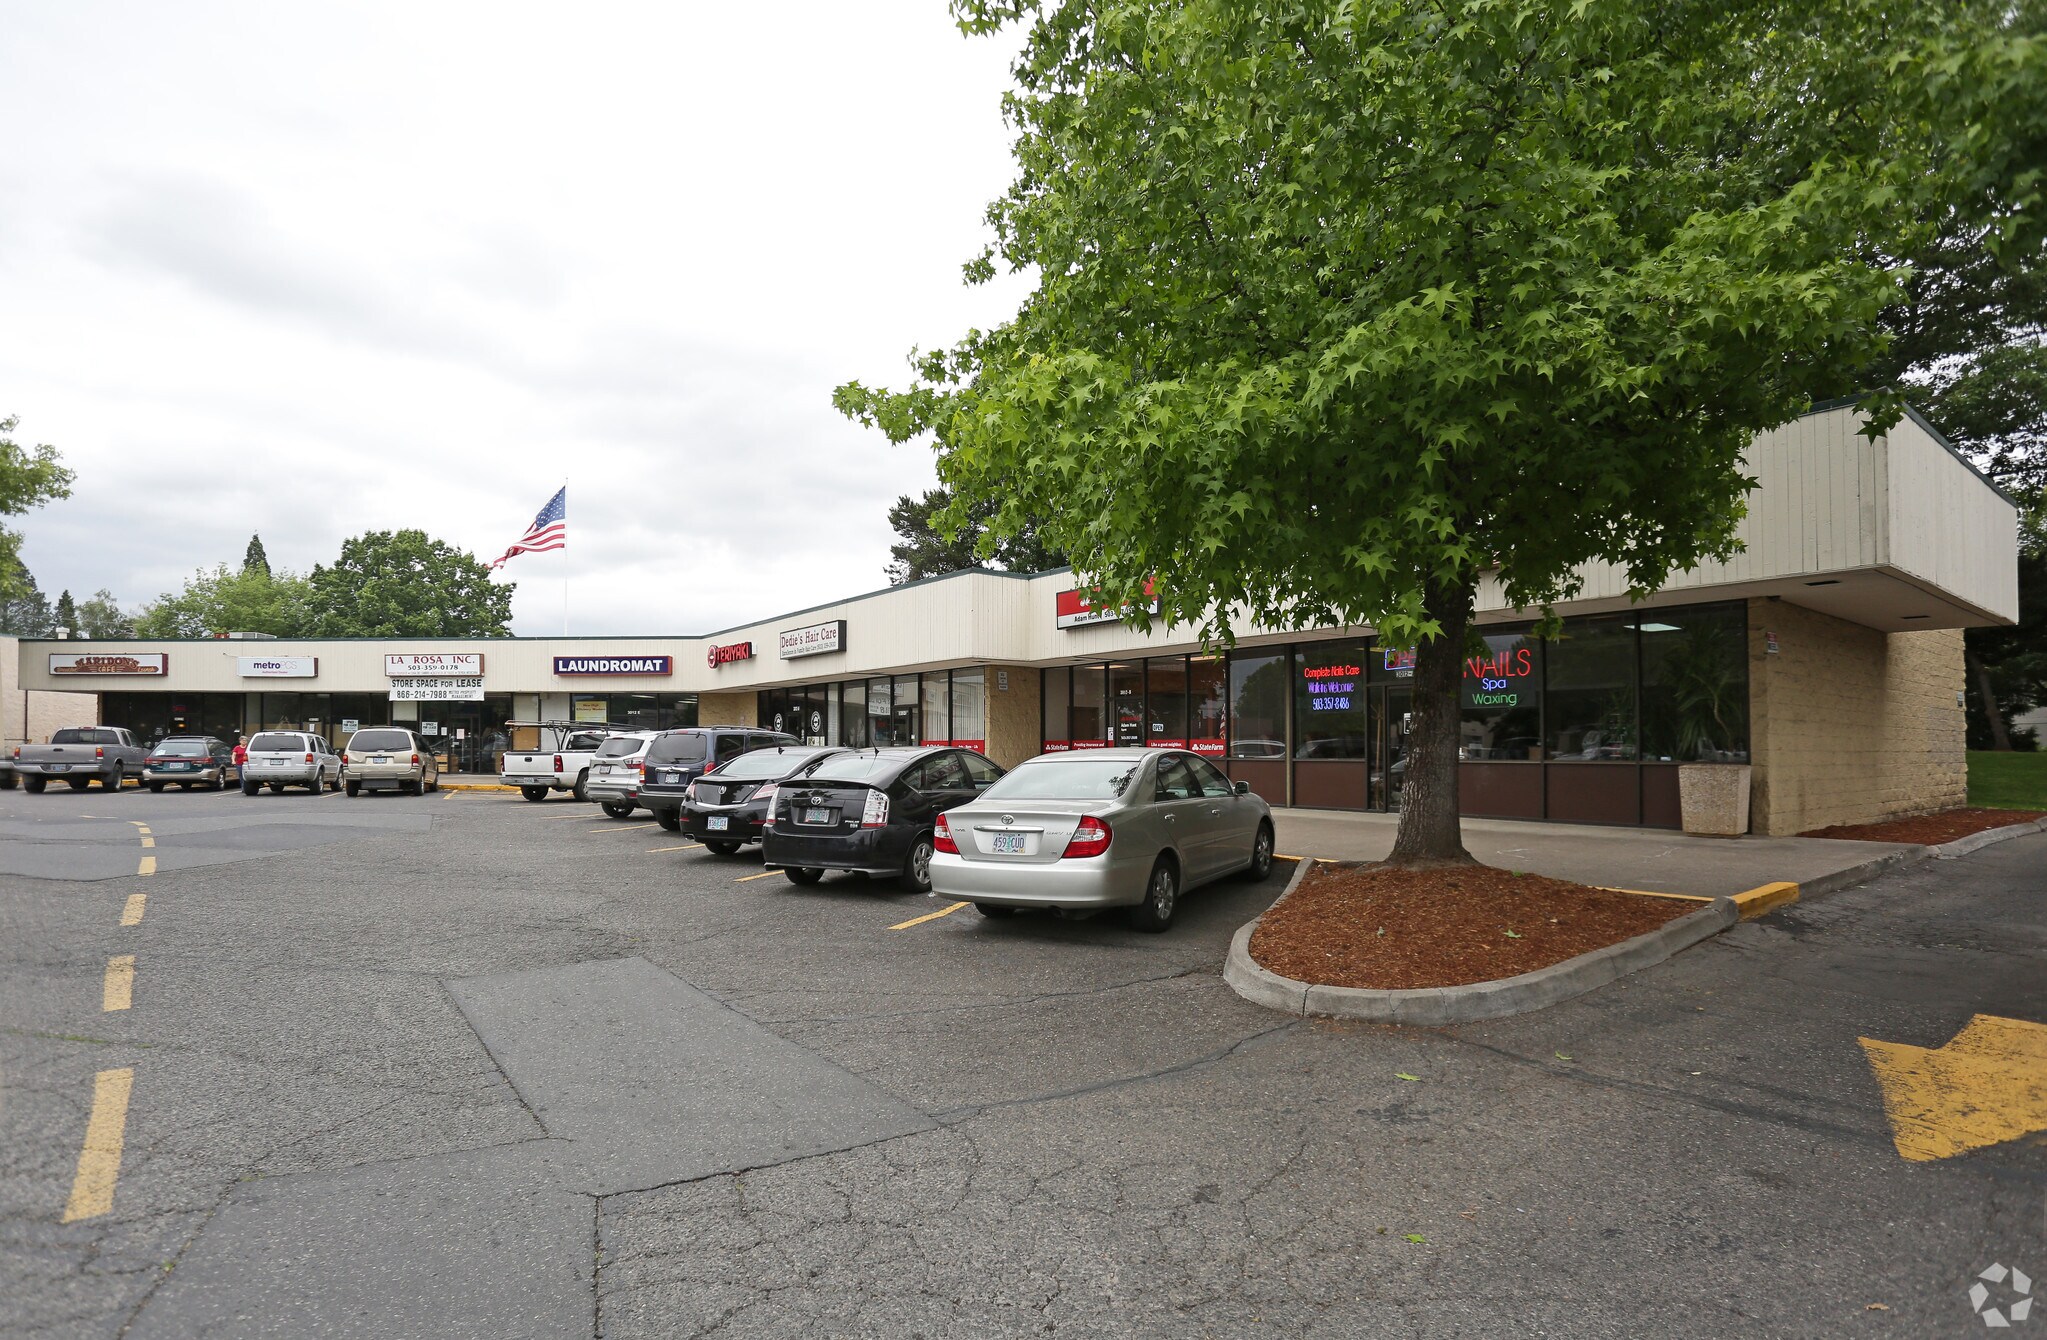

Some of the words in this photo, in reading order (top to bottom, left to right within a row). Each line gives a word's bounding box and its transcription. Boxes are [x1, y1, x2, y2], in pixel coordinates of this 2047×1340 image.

[1074, 614, 1088, 623] Adam
[781, 633, 803, 648] Dedie's
[804, 631, 819, 644] Hair
[820, 628, 837, 641] Care
[715, 643, 749, 662] TERIYAKI
[1387, 648, 1416, 669] OPE
[391, 656, 404, 664] LA
[413, 656, 443, 664] ROSA
[452, 656, 476, 664] INC.
[558, 660, 664, 672] LAUNDROMAT
[1463, 649, 1531, 679] NAILS
[1304, 666, 1331, 680] Complete
[1331, 665, 1344, 676] Nails
[1345, 664, 1360, 676] Care
[391, 679, 413, 688] STORE
[416, 679, 438, 688] SPACE
[456, 679, 482, 688] LEASE
[1328, 681, 1355, 693] Welcome
[1482, 677, 1507, 692] Spa
[396, 690, 448, 699] 866-214-7988
[1472, 692, 1518, 707] Waxing
[993, 837, 1007, 848] 459
[1010, 837, 1025, 848] CUD
